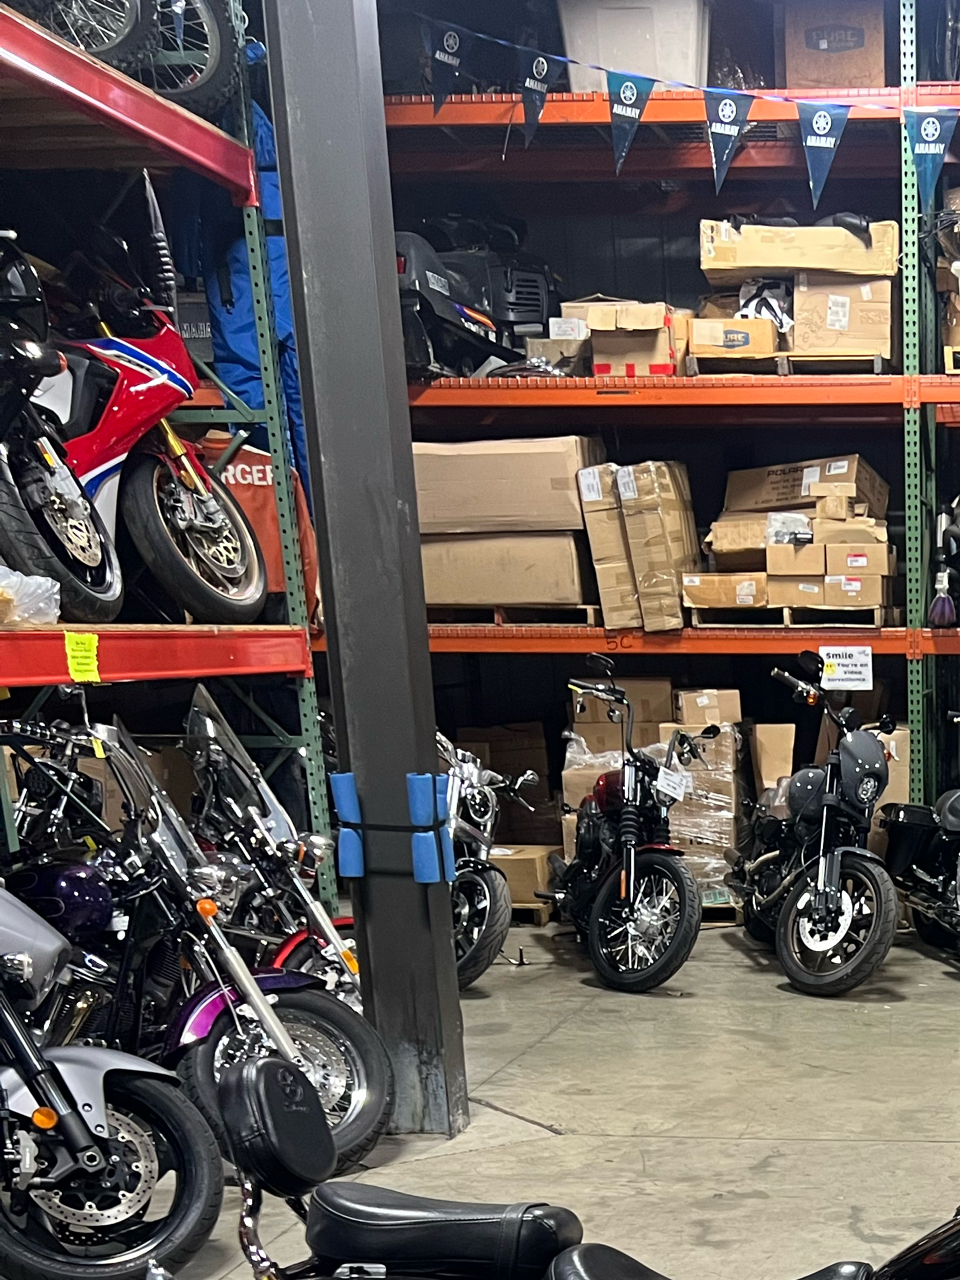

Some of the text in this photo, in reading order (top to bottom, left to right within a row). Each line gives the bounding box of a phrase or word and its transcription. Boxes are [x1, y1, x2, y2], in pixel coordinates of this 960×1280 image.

[177, 322, 212, 338] MAHA
[767, 465, 814, 477] POLAR
[606, 635, 633, 650] 5C
